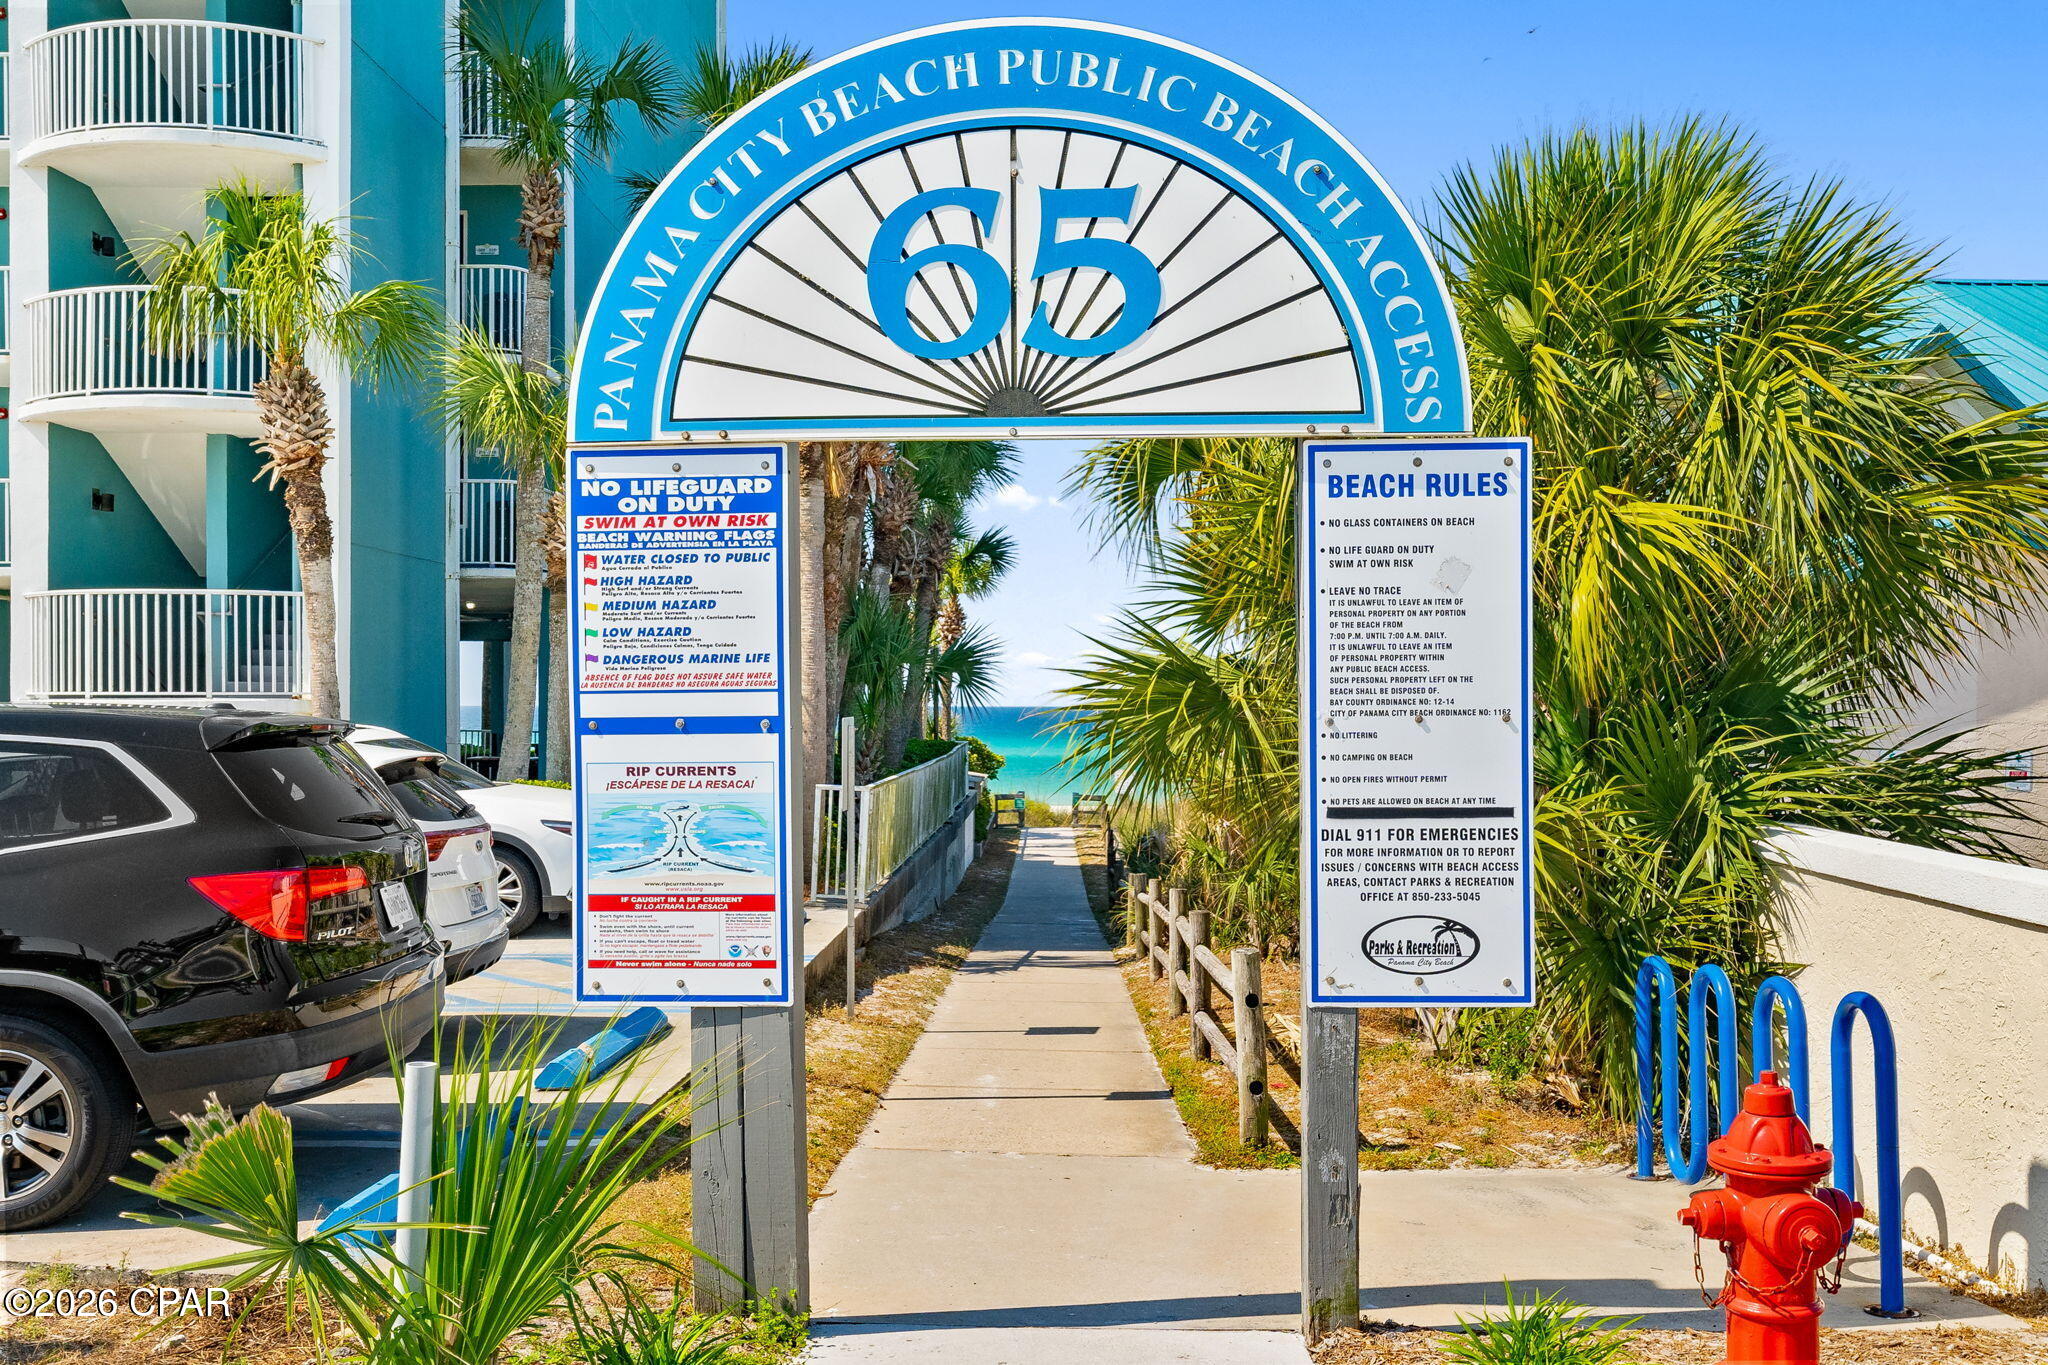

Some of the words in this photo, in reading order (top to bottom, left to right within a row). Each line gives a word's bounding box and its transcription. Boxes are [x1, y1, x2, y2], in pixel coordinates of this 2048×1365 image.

[594, 226, 699, 431] PANAMA
[688, 124, 791, 223] CITY
[801, 52, 979, 138] BEACH
[999, 49, 1198, 113] PUBLIC
[1202, 92, 1362, 229] BEACH
[1346, 234, 1442, 425] ACCESS
[867, 185, 1162, 358] 65
[581, 481, 620, 496] NO
[630, 478, 772, 495] LIFEGUARD
[1328, 474, 1414, 498] BEACH
[1426, 473, 1507, 496] RULES
[618, 497, 657, 512] ON
[668, 496, 735, 511] DUTY
[584, 517, 636, 529] SWIM
[643, 516, 667, 528] AT
[673, 516, 720, 527] OWN
[727, 515, 769, 526] RISK
[1329, 519, 1340, 527] NO
[1344, 519, 1370, 527] GLASS
[1374, 518, 1427, 526] CONTAINERS
[1431, 518, 1442, 526] ON
[1446, 518, 1474, 526] BEACH
[577, 533, 628, 542] BEACH
[634, 532, 718, 541] WARNING
[724, 530, 775, 540] FLAGS
[1329, 546, 1340, 554] NO
[1344, 546, 1361, 554] LIFE
[1365, 546, 1394, 554] GUARD
[1398, 546, 1409, 554] ON
[602, 555, 645, 564] WATER
[651, 554, 698, 564] CLOSED
[704, 554, 720, 563] TO
[726, 553, 770, 562] PUBLIC
[1330, 560, 1353, 568] SWIM
[1394, 559, 1413, 567] RISK
[600, 576, 633, 586] HIGH
[638, 576, 692, 585] HAZARD
[1329, 587, 1355, 595] LEAVE
[1359, 587, 1370, 595] NO
[602, 601, 656, 610] MEDIUM
[662, 600, 716, 610] HAZARD
[603, 628, 632, 637] LOW
[637, 627, 691, 636] HAZARD
[603, 655, 684, 664] DANGEROUS
[689, 654, 740, 663] MARINE
[745, 654, 770, 663] LIFE
[622, 674, 632, 682] OF
[634, 674, 652, 682] FLAG
[654, 674, 675, 682] DOES
[677, 673, 692, 682] NOT
[693, 673, 723, 682] ASSURE
[725, 672, 744, 681] SAFE
[627, 767, 650, 776] RIP
[656, 766, 736, 776] CURRENTS
[689, 780, 702, 788] LA
[1322, 829, 1351, 841] DIAL
[1357, 829, 1380, 841] 911
[1388, 829, 1414, 841] FOR
[1420, 828, 1518, 840] EMERGENCIES
[1325, 849, 1342, 857] FOR
[1347, 848, 1373, 857] MORE
[1378, 848, 1442, 856] INFORMATION
[1447, 848, 1459, 856] OR
[1463, 848, 1474, 856] TO
[1478, 848, 1515, 856] REPORT
[1322, 863, 1354, 872] ISSUES
[1365, 863, 1415, 871] CONCERNS
[1419, 863, 1443, 871] WITH
[1447, 863, 1478, 871] BEACH
[1482, 862, 1519, 871] ACCESS
[1327, 878, 1360, 887] AREAS,
[1364, 878, 1407, 886] CONTACT
[1411, 878, 1441, 886] PARKS
[1445, 878, 1451, 886] &
[1455, 877, 1514, 886] RECREATION
[1360, 893, 1393, 901] OFFICE
[1397, 893, 1409, 901] AT
[1412, 892, 1480, 901] 850-233-5045
[317, 926, 354, 940] PILOT
[1369, 940, 1394, 956] Parks
[1397, 940, 1403, 955] &
[1406, 940, 1455, 955] Recreation
[1388, 958, 1414, 966] Panama
[1417, 958, 1432, 967] City
[1434, 958, 1454, 966] Beach
